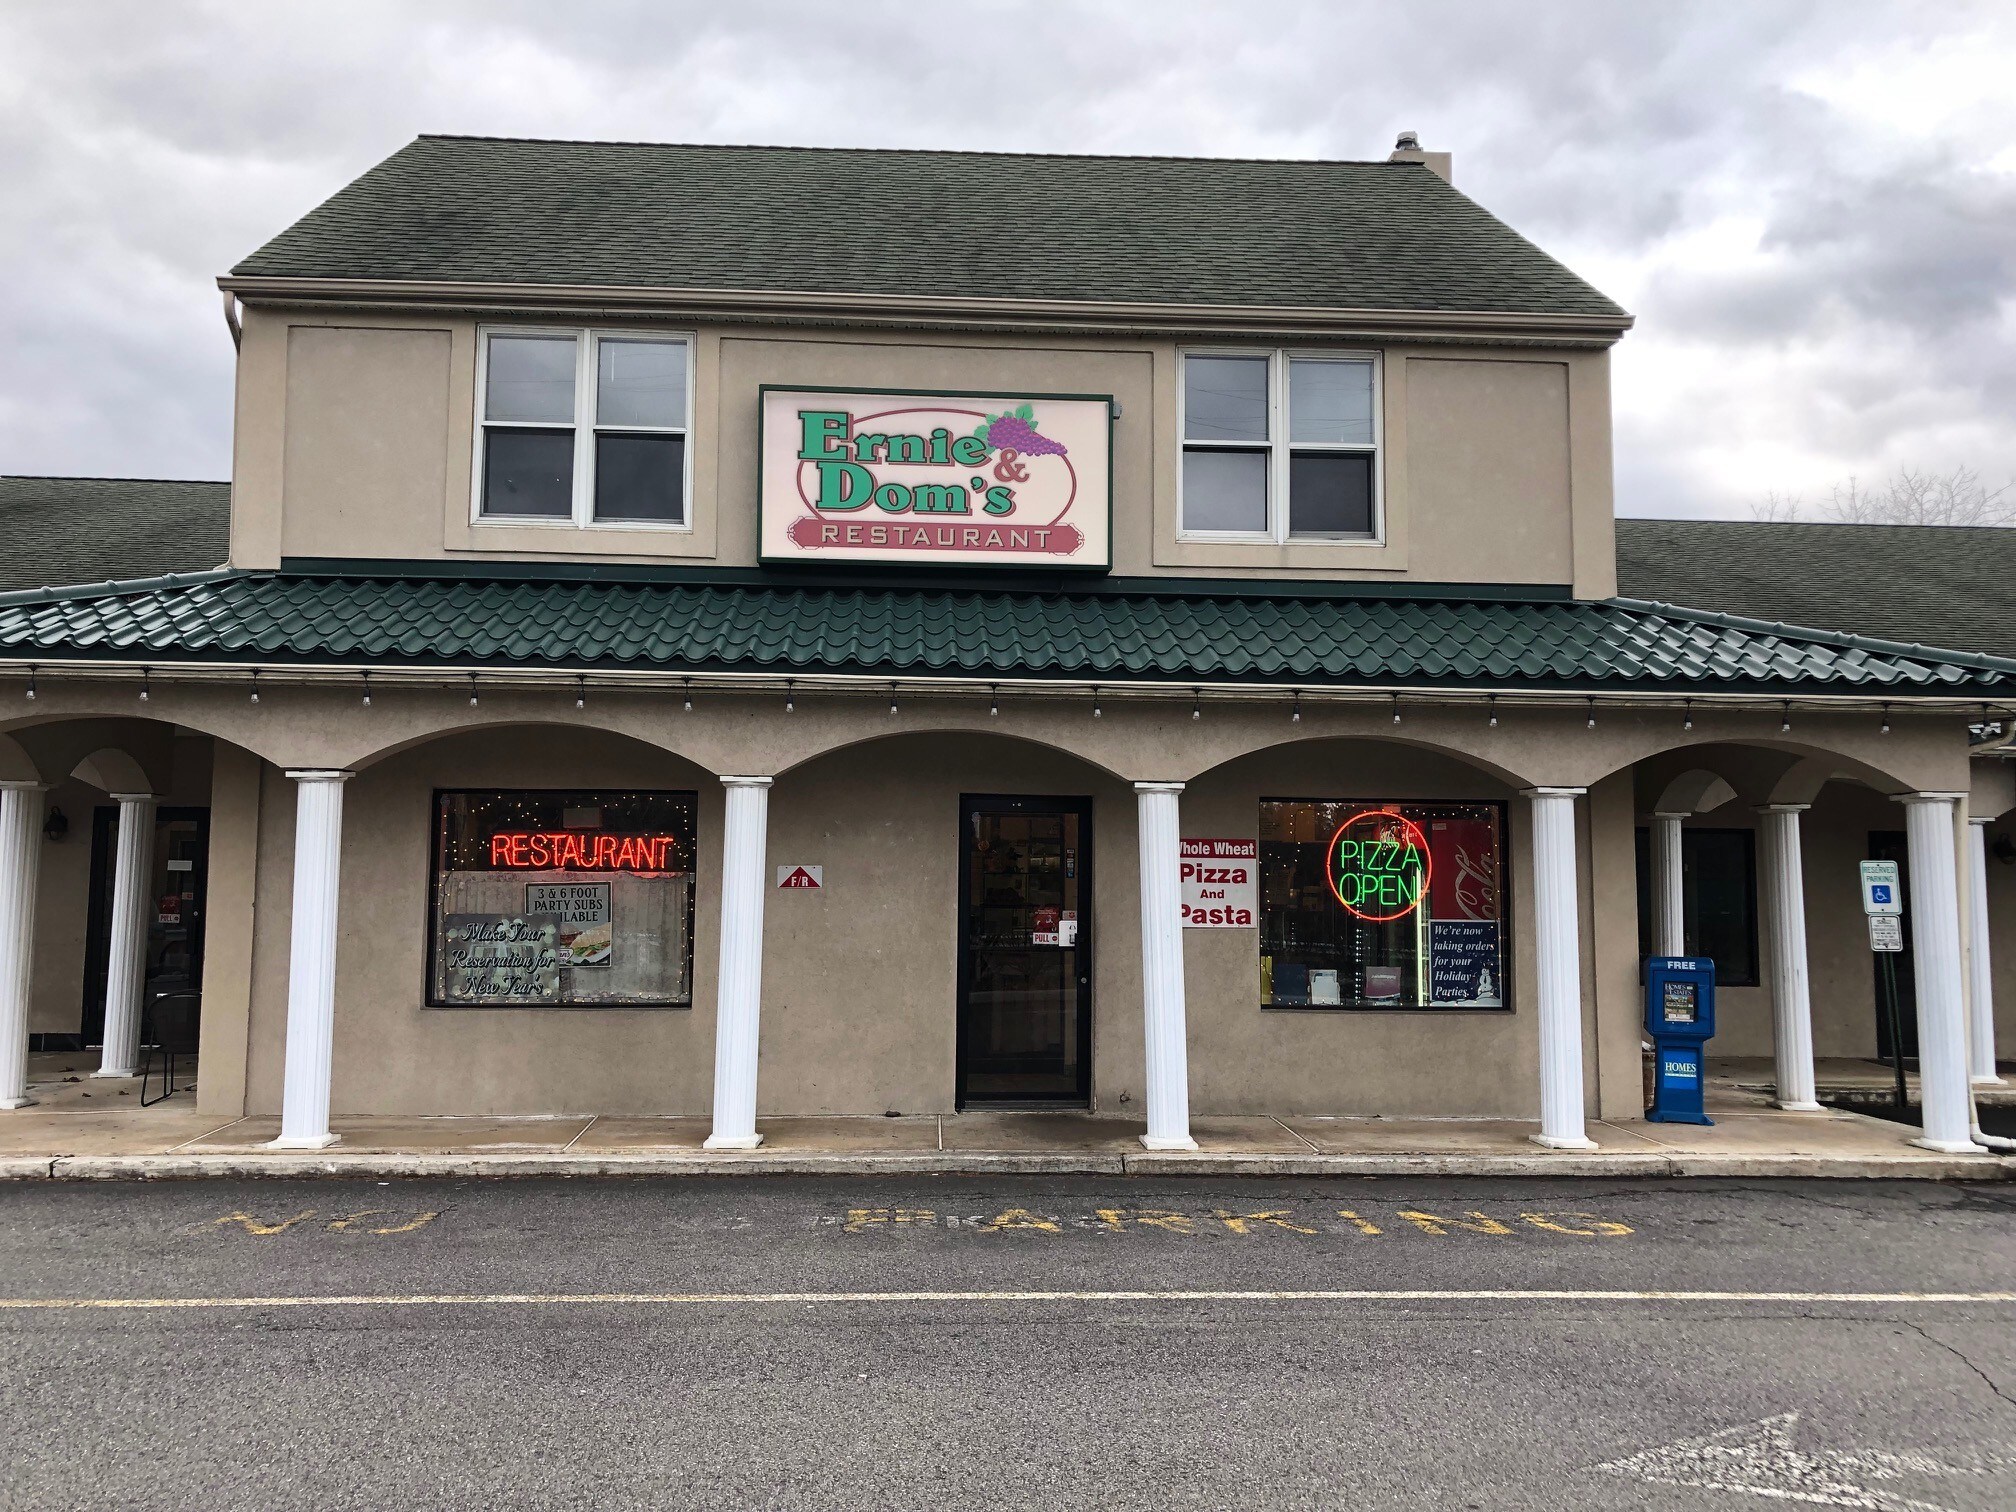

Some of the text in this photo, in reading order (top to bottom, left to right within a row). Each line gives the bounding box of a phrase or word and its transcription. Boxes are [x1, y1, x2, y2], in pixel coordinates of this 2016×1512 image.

[798, 410, 990, 467] Ernie
[994, 447, 1029, 483] &
[816, 460, 1017, 517] Dom's
[820, 524, 1052, 549] RESTAURANT
[491, 833, 675, 869] RESTAURANT
[1213, 841, 1254, 856] Wheat
[1341, 840, 1422, 871] PIZZA
[1180, 863, 1247, 884] Pizza
[1863, 866, 1895, 874] RESERVED
[538, 887, 599, 899] 3 & 6 FOOT
[1200, 889, 1224, 899] And
[1339, 873, 1416, 906] OPEN
[534, 899, 603, 911] PARTY SUBS
[461, 922, 547, 942] Make Your
[1035, 933, 1050, 943] PULL
[1434, 925, 1461, 935] We're
[1433, 941, 1495, 953] taking orders
[450, 949, 534, 969] Reservation
[527, 948, 556, 974] for
[1433, 956, 1472, 968] for your
[1667, 961, 1696, 970] FREE
[460, 974, 544, 995] New Year's
[1435, 971, 1471, 983] Holiday
[1665, 1062, 1696, 1072] HOMES
[843, 1208, 1635, 1236] PARKING
